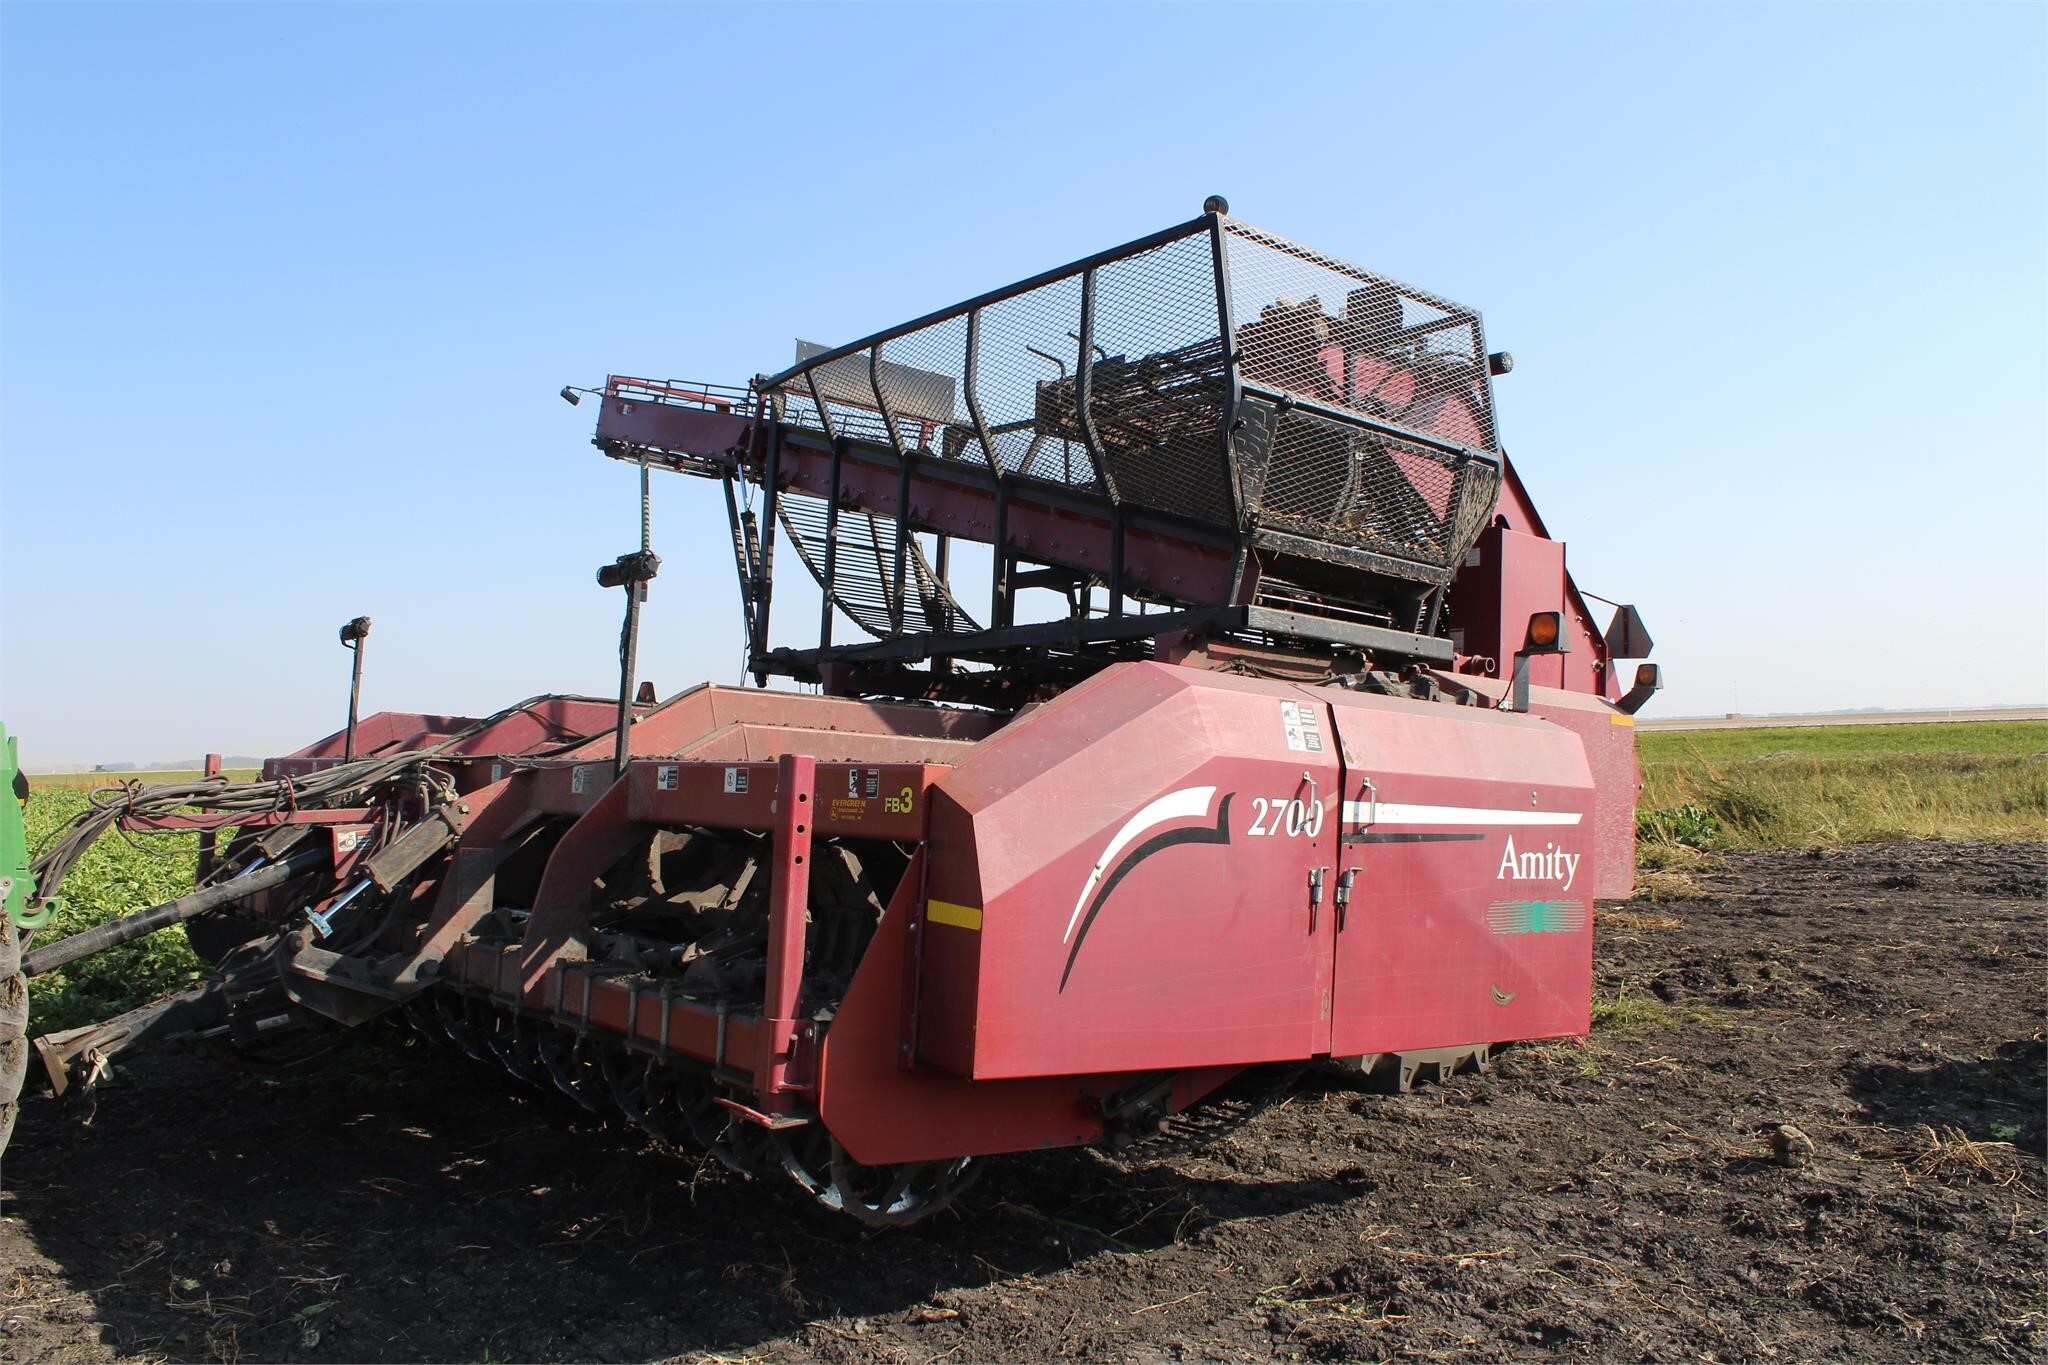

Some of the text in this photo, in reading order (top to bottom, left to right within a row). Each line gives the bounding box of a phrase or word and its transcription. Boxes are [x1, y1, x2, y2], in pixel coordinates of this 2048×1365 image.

[831, 799, 867, 808] EVERGREEN
[884, 787, 913, 814] FB3
[1247, 797, 1324, 838] 2700
[1496, 833, 1581, 892] Amity
